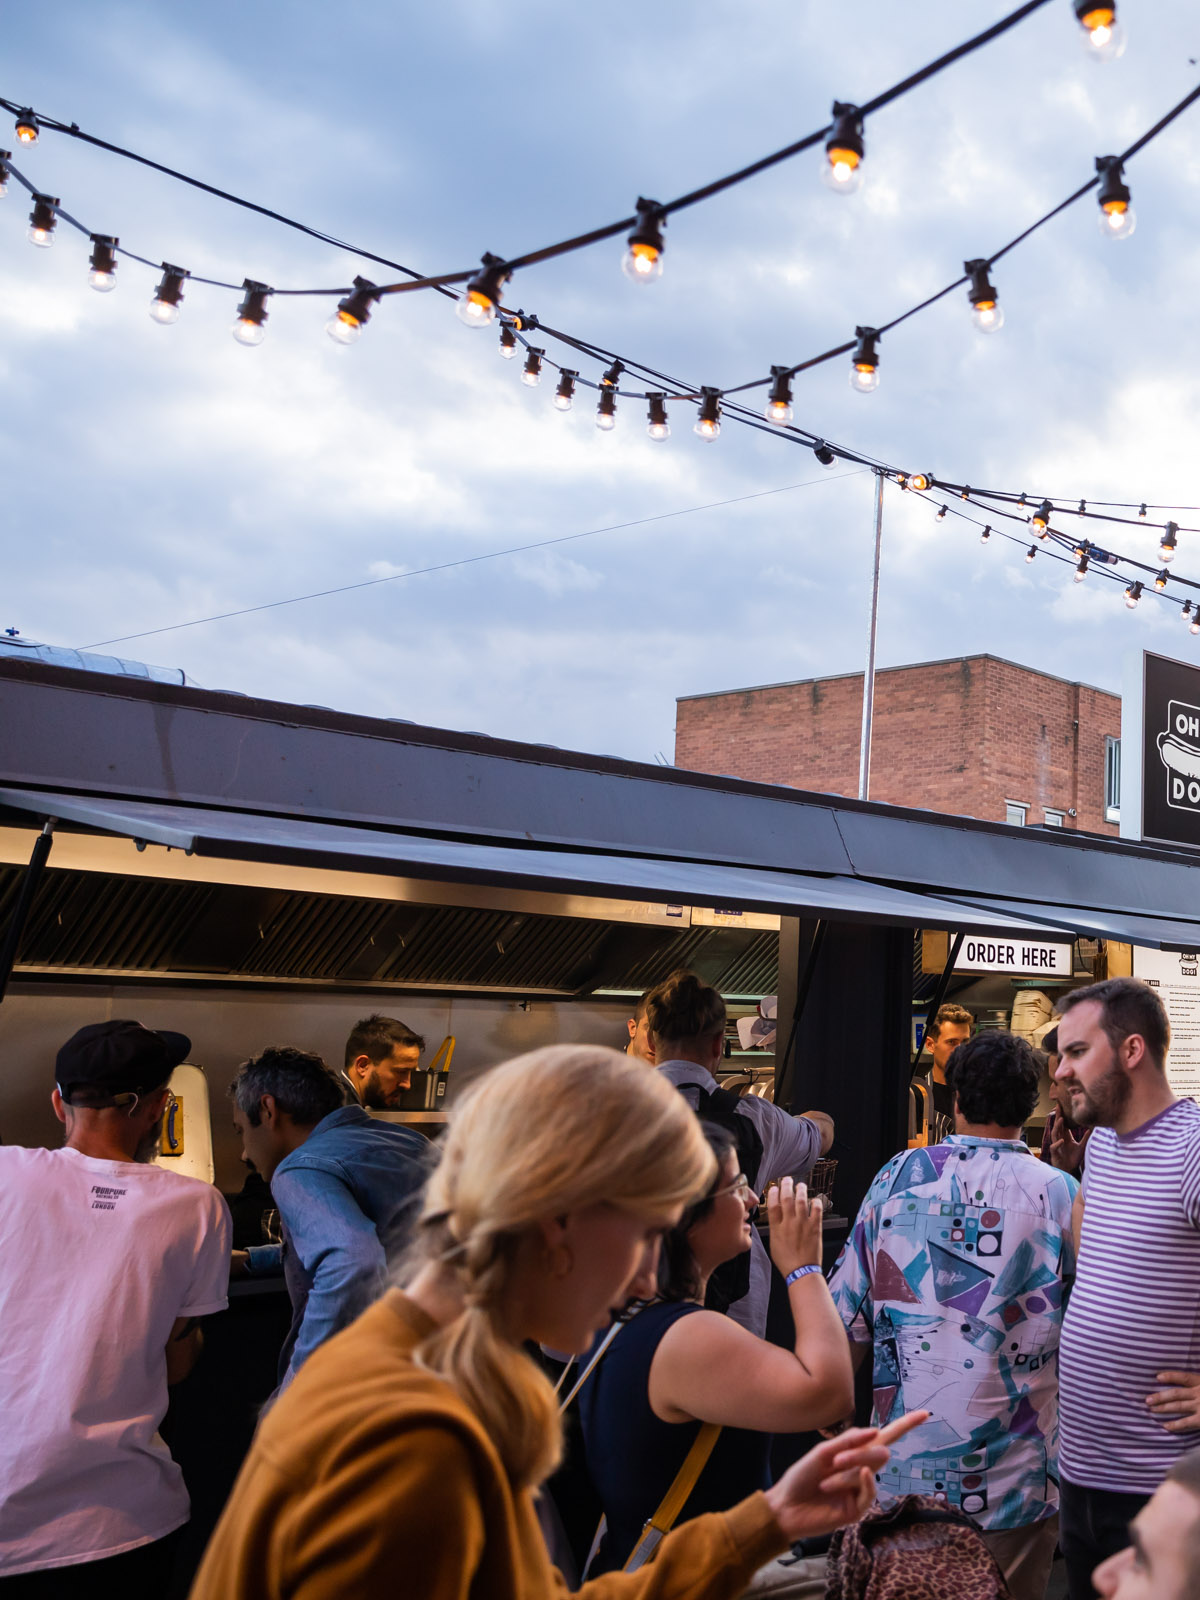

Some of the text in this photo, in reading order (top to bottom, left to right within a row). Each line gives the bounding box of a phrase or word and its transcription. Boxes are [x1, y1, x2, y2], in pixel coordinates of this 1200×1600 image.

[1175, 713, 1200, 738] OH
[967, 942, 1057, 968] ORDER HERE
[91, 1186, 128, 1195] FOURPURE
